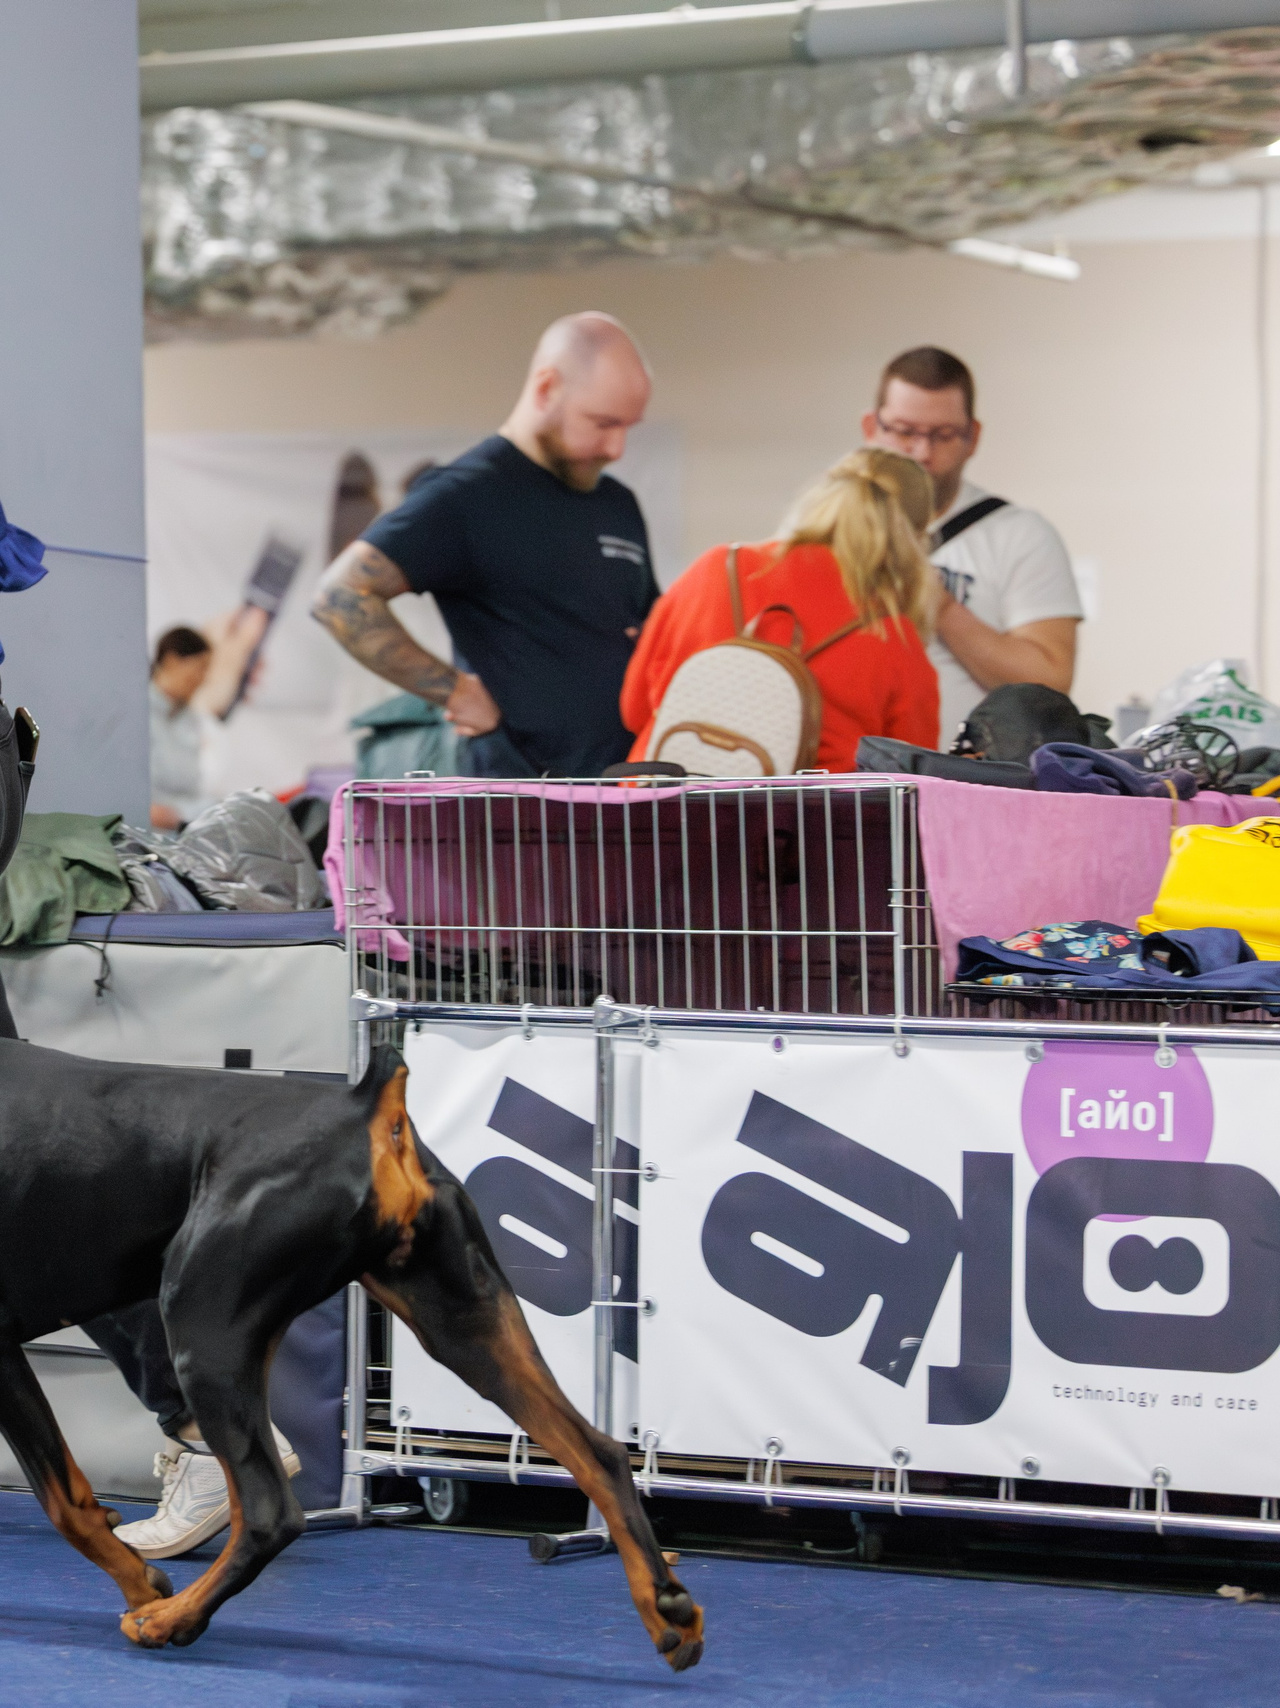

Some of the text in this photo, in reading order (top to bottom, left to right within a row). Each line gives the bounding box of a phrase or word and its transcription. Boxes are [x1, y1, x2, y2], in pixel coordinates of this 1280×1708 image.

[1052, 1383, 1259, 1411] technology and care
